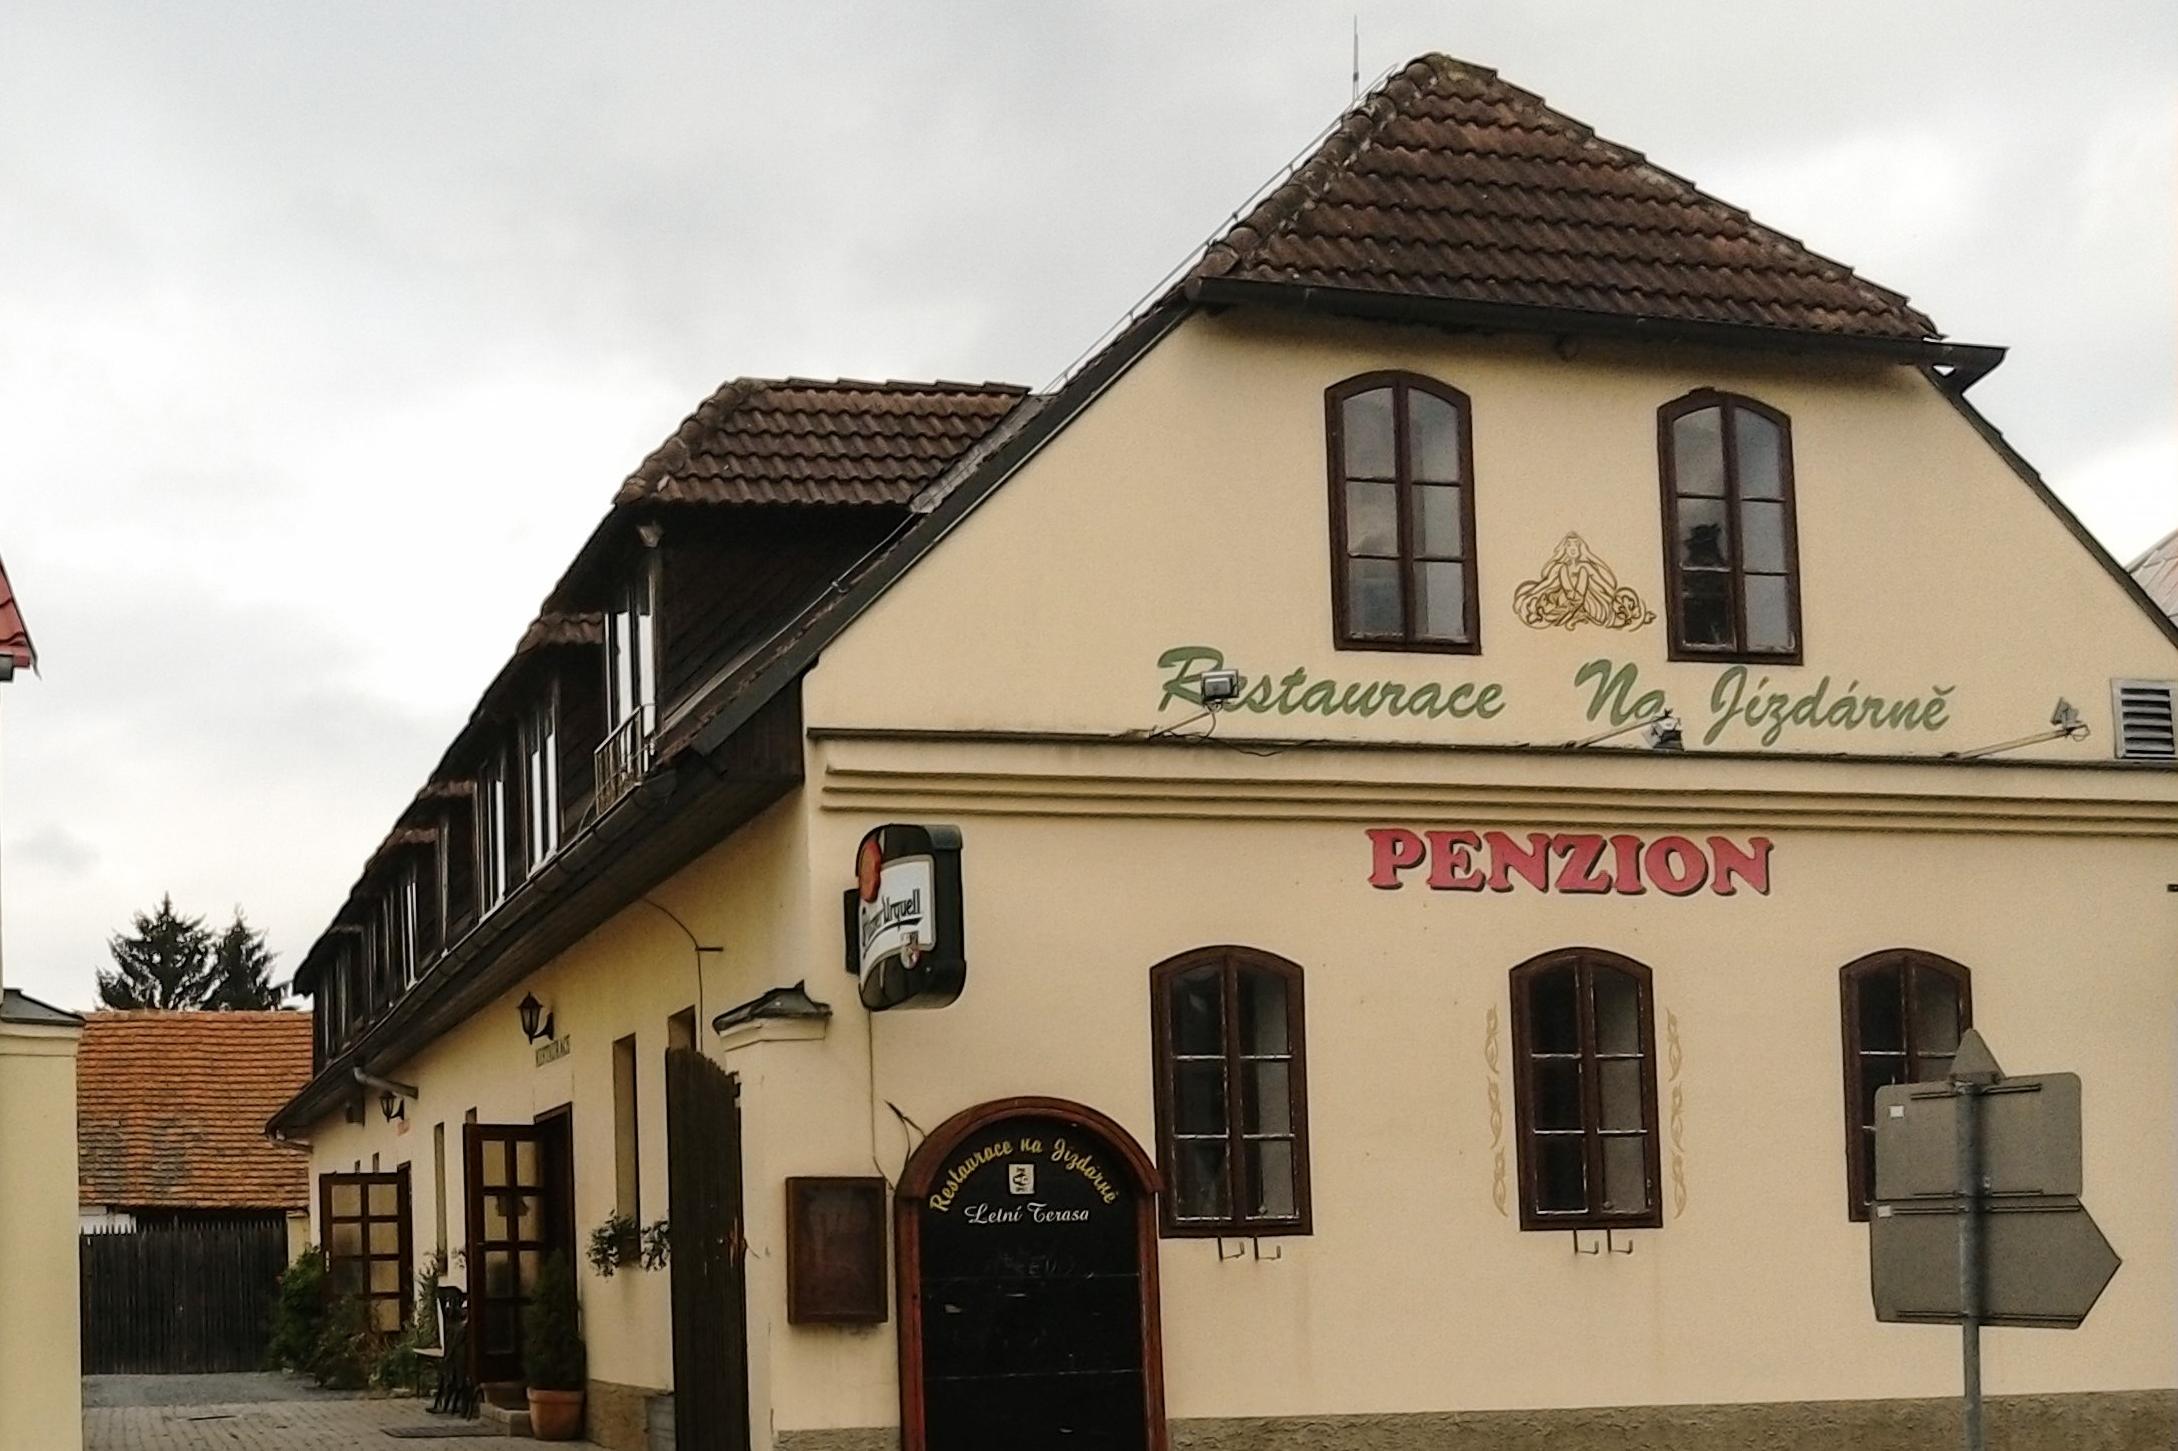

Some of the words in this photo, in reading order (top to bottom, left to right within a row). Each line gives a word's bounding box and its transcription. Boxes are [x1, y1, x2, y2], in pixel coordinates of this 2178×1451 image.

[1574, 659, 1666, 726] Na
[1703, 665, 1956, 747] Jízdárně
[1365, 828, 1774, 896] PENZION
[881, 888, 921, 930] Urquell
[929, 1140, 1014, 1212] Restaurace
[1020, 1138, 1043, 1154] na
[964, 1202, 1023, 1225] Letní
[1027, 1201, 1090, 1224] Terasa
